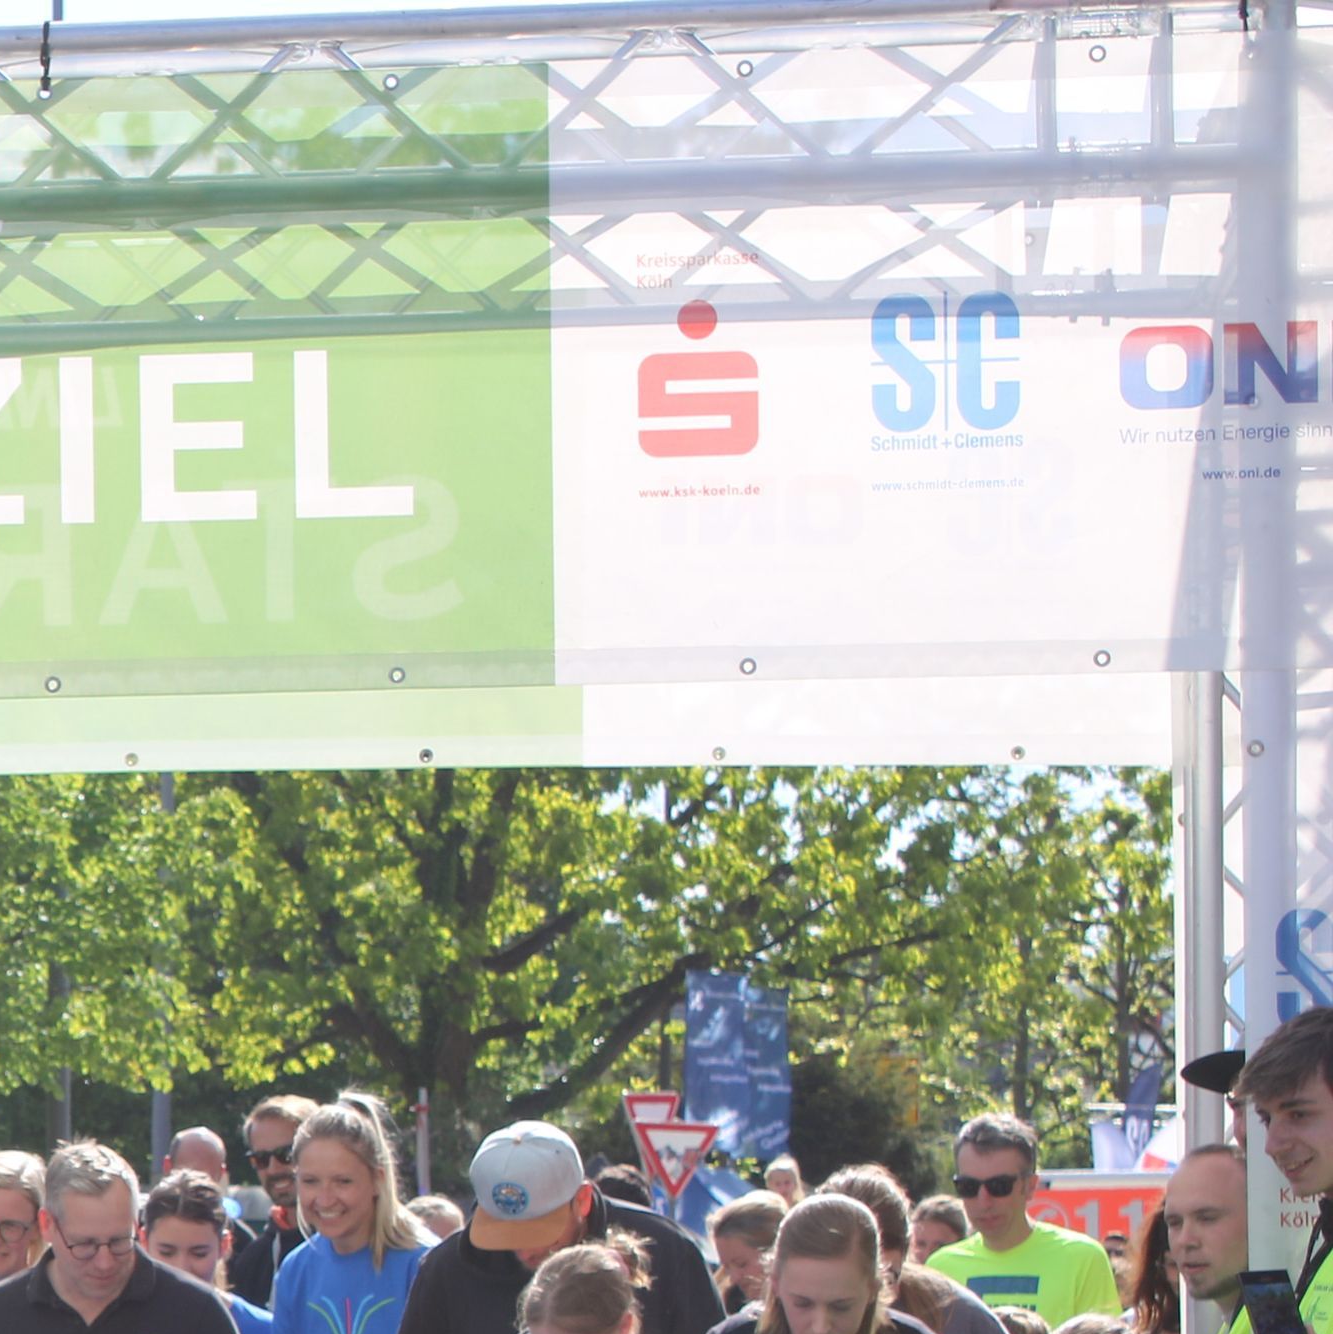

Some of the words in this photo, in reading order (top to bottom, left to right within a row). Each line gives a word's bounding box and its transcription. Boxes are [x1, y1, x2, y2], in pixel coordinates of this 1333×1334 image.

[636, 250, 760, 271] Kreissparkasse
[636, 272, 674, 291] Köln
[1119, 320, 1333, 410] ON
[871, 434, 938, 453] Schmidt
[953, 431, 1024, 451] Clemens
[1119, 428, 1150, 444] Wir
[1155, 427, 1216, 443] nutzen
[1221, 423, 1290, 444] Energie
[1201, 466, 1282, 480] www.oni.de
[638, 484, 761, 500] www.ksk-koeln.de
[871, 476, 1025, 494] www.schmidt-clemens.de
